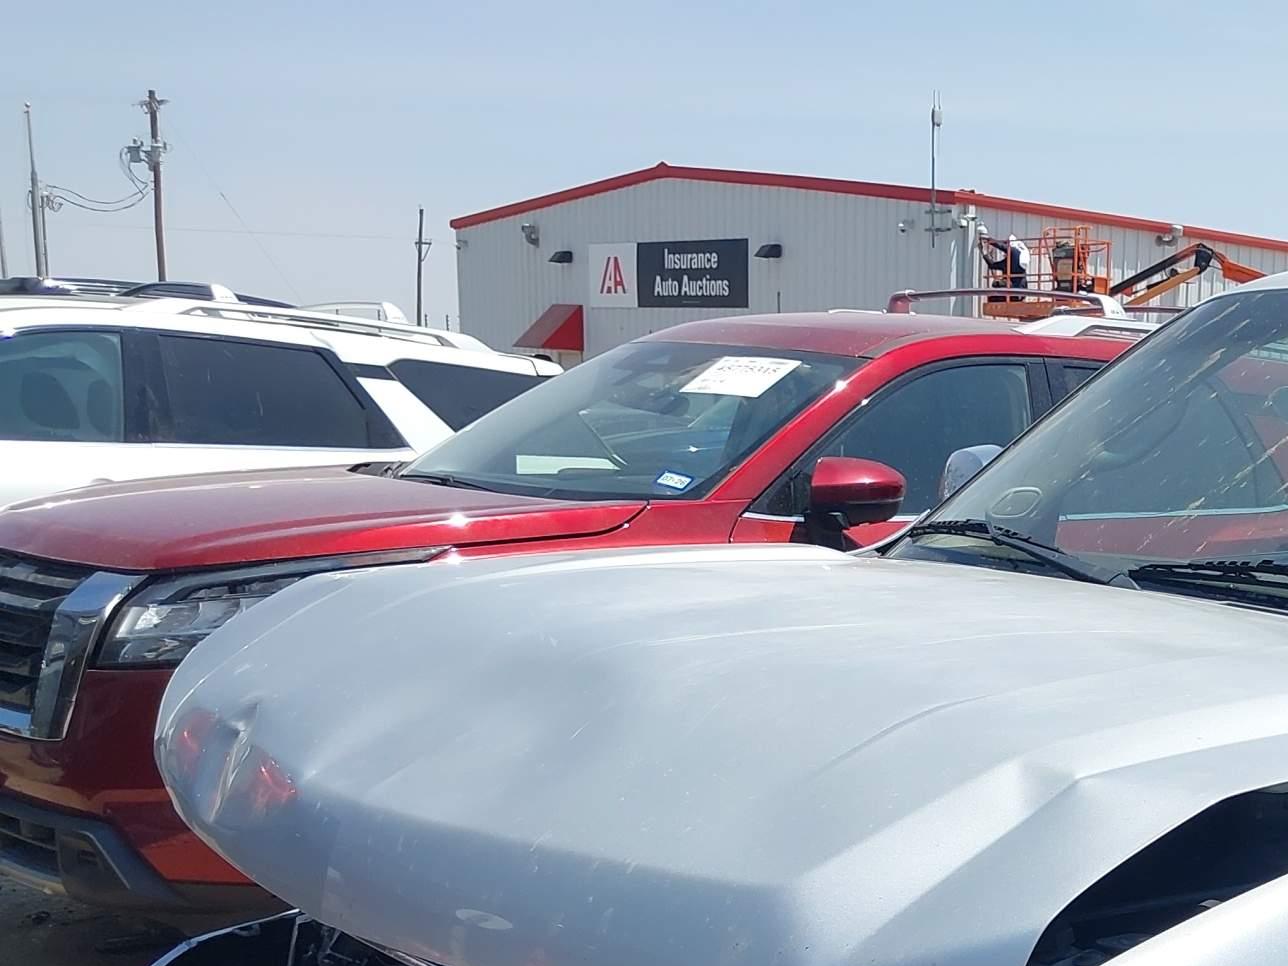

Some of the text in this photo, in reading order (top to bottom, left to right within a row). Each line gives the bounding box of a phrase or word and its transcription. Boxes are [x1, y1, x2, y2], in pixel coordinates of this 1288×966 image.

[664, 249, 718, 270] Insurance
[654, 274, 730, 297] Auto Auctions
